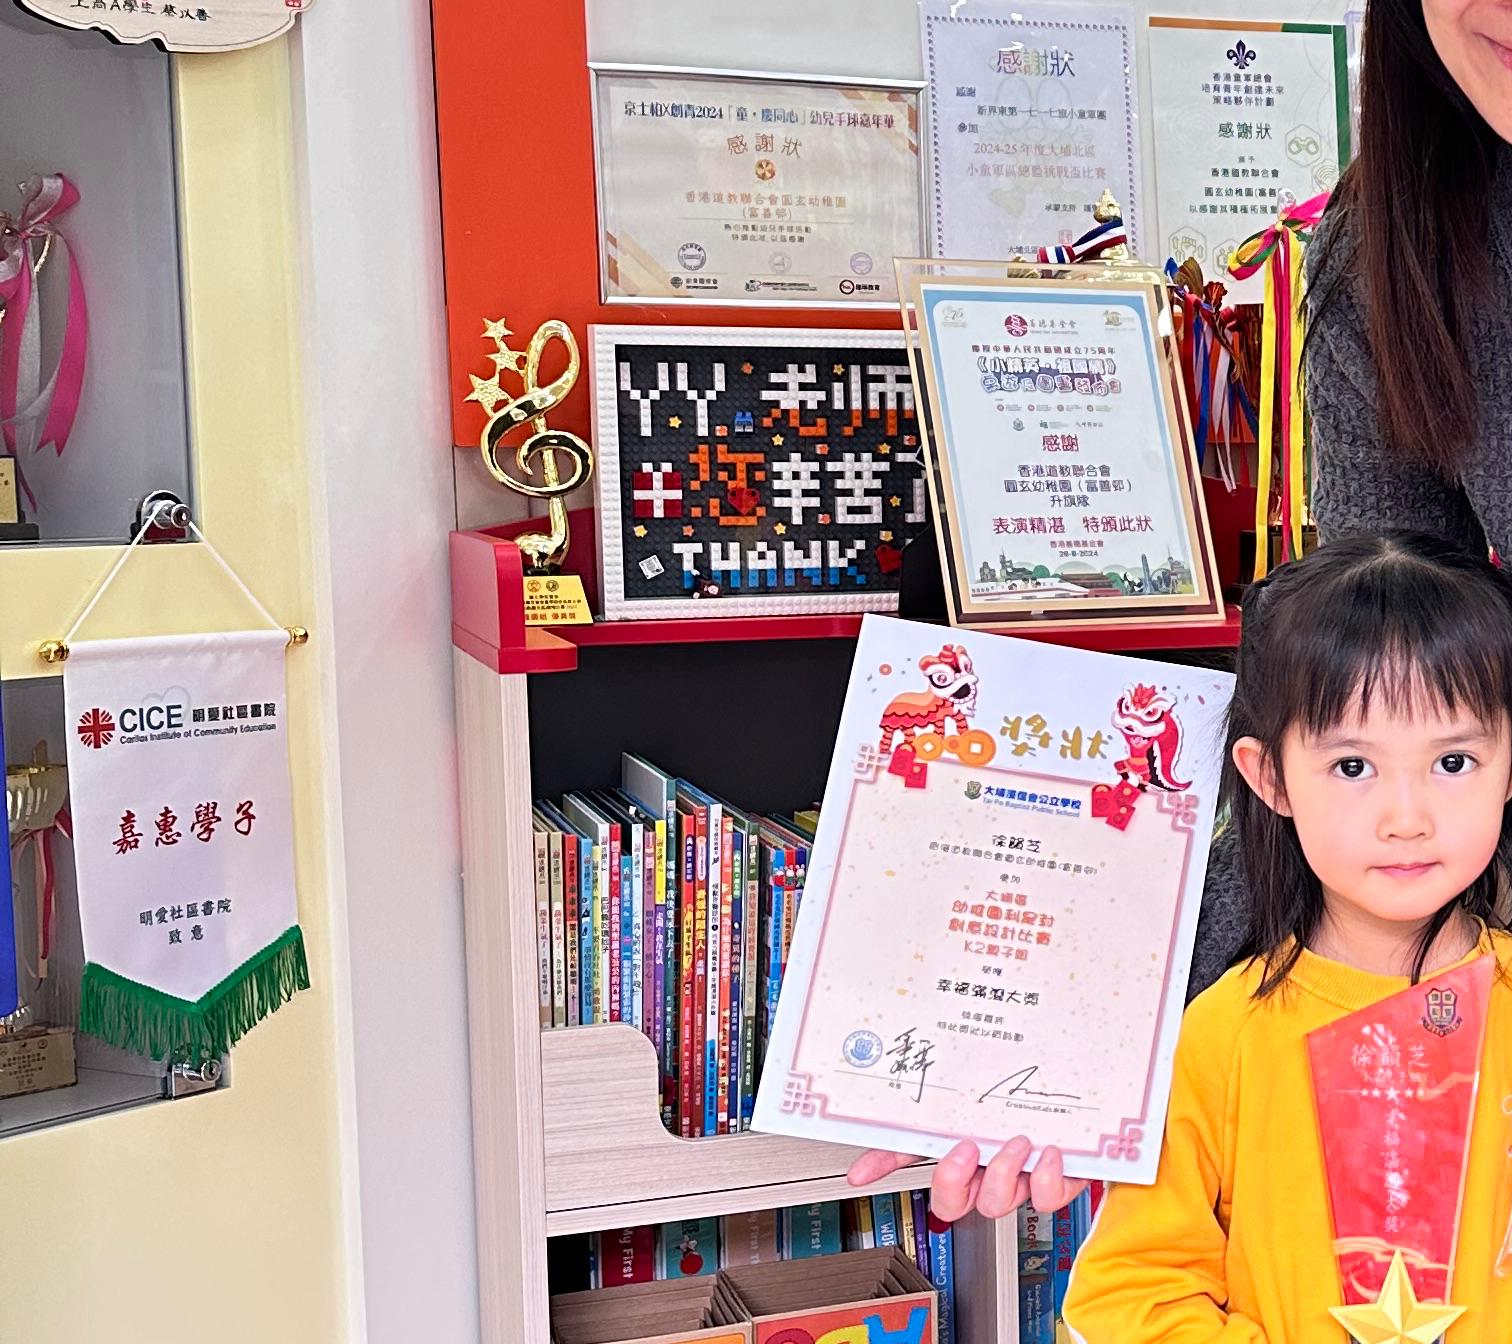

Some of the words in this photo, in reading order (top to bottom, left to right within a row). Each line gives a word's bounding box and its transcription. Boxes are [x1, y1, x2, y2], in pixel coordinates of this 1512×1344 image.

[997, 48, 1076, 77] 感謝狀
[727, 132, 803, 158] 感謝狀
[1218, 122, 1272, 140] 感謝狀
[619, 362, 726, 437] YY
[760, 363, 916, 437] 老师
[1042, 434, 1080, 452] 感謝
[1017, 464, 1111, 478] 香港道教聯合會
[992, 517, 1066, 534] 表演精湛
[1082, 515, 1155, 533] 特頒此狀
[672, 540, 867, 588] THANK
[119, 704, 184, 733] CICE
[192, 703, 277, 723] 明愛社區書院
[112, 800, 257, 856] 嘉惠學子
[139, 898, 232, 927] 明愛社區書院
[622, 1248, 634, 1279] First
